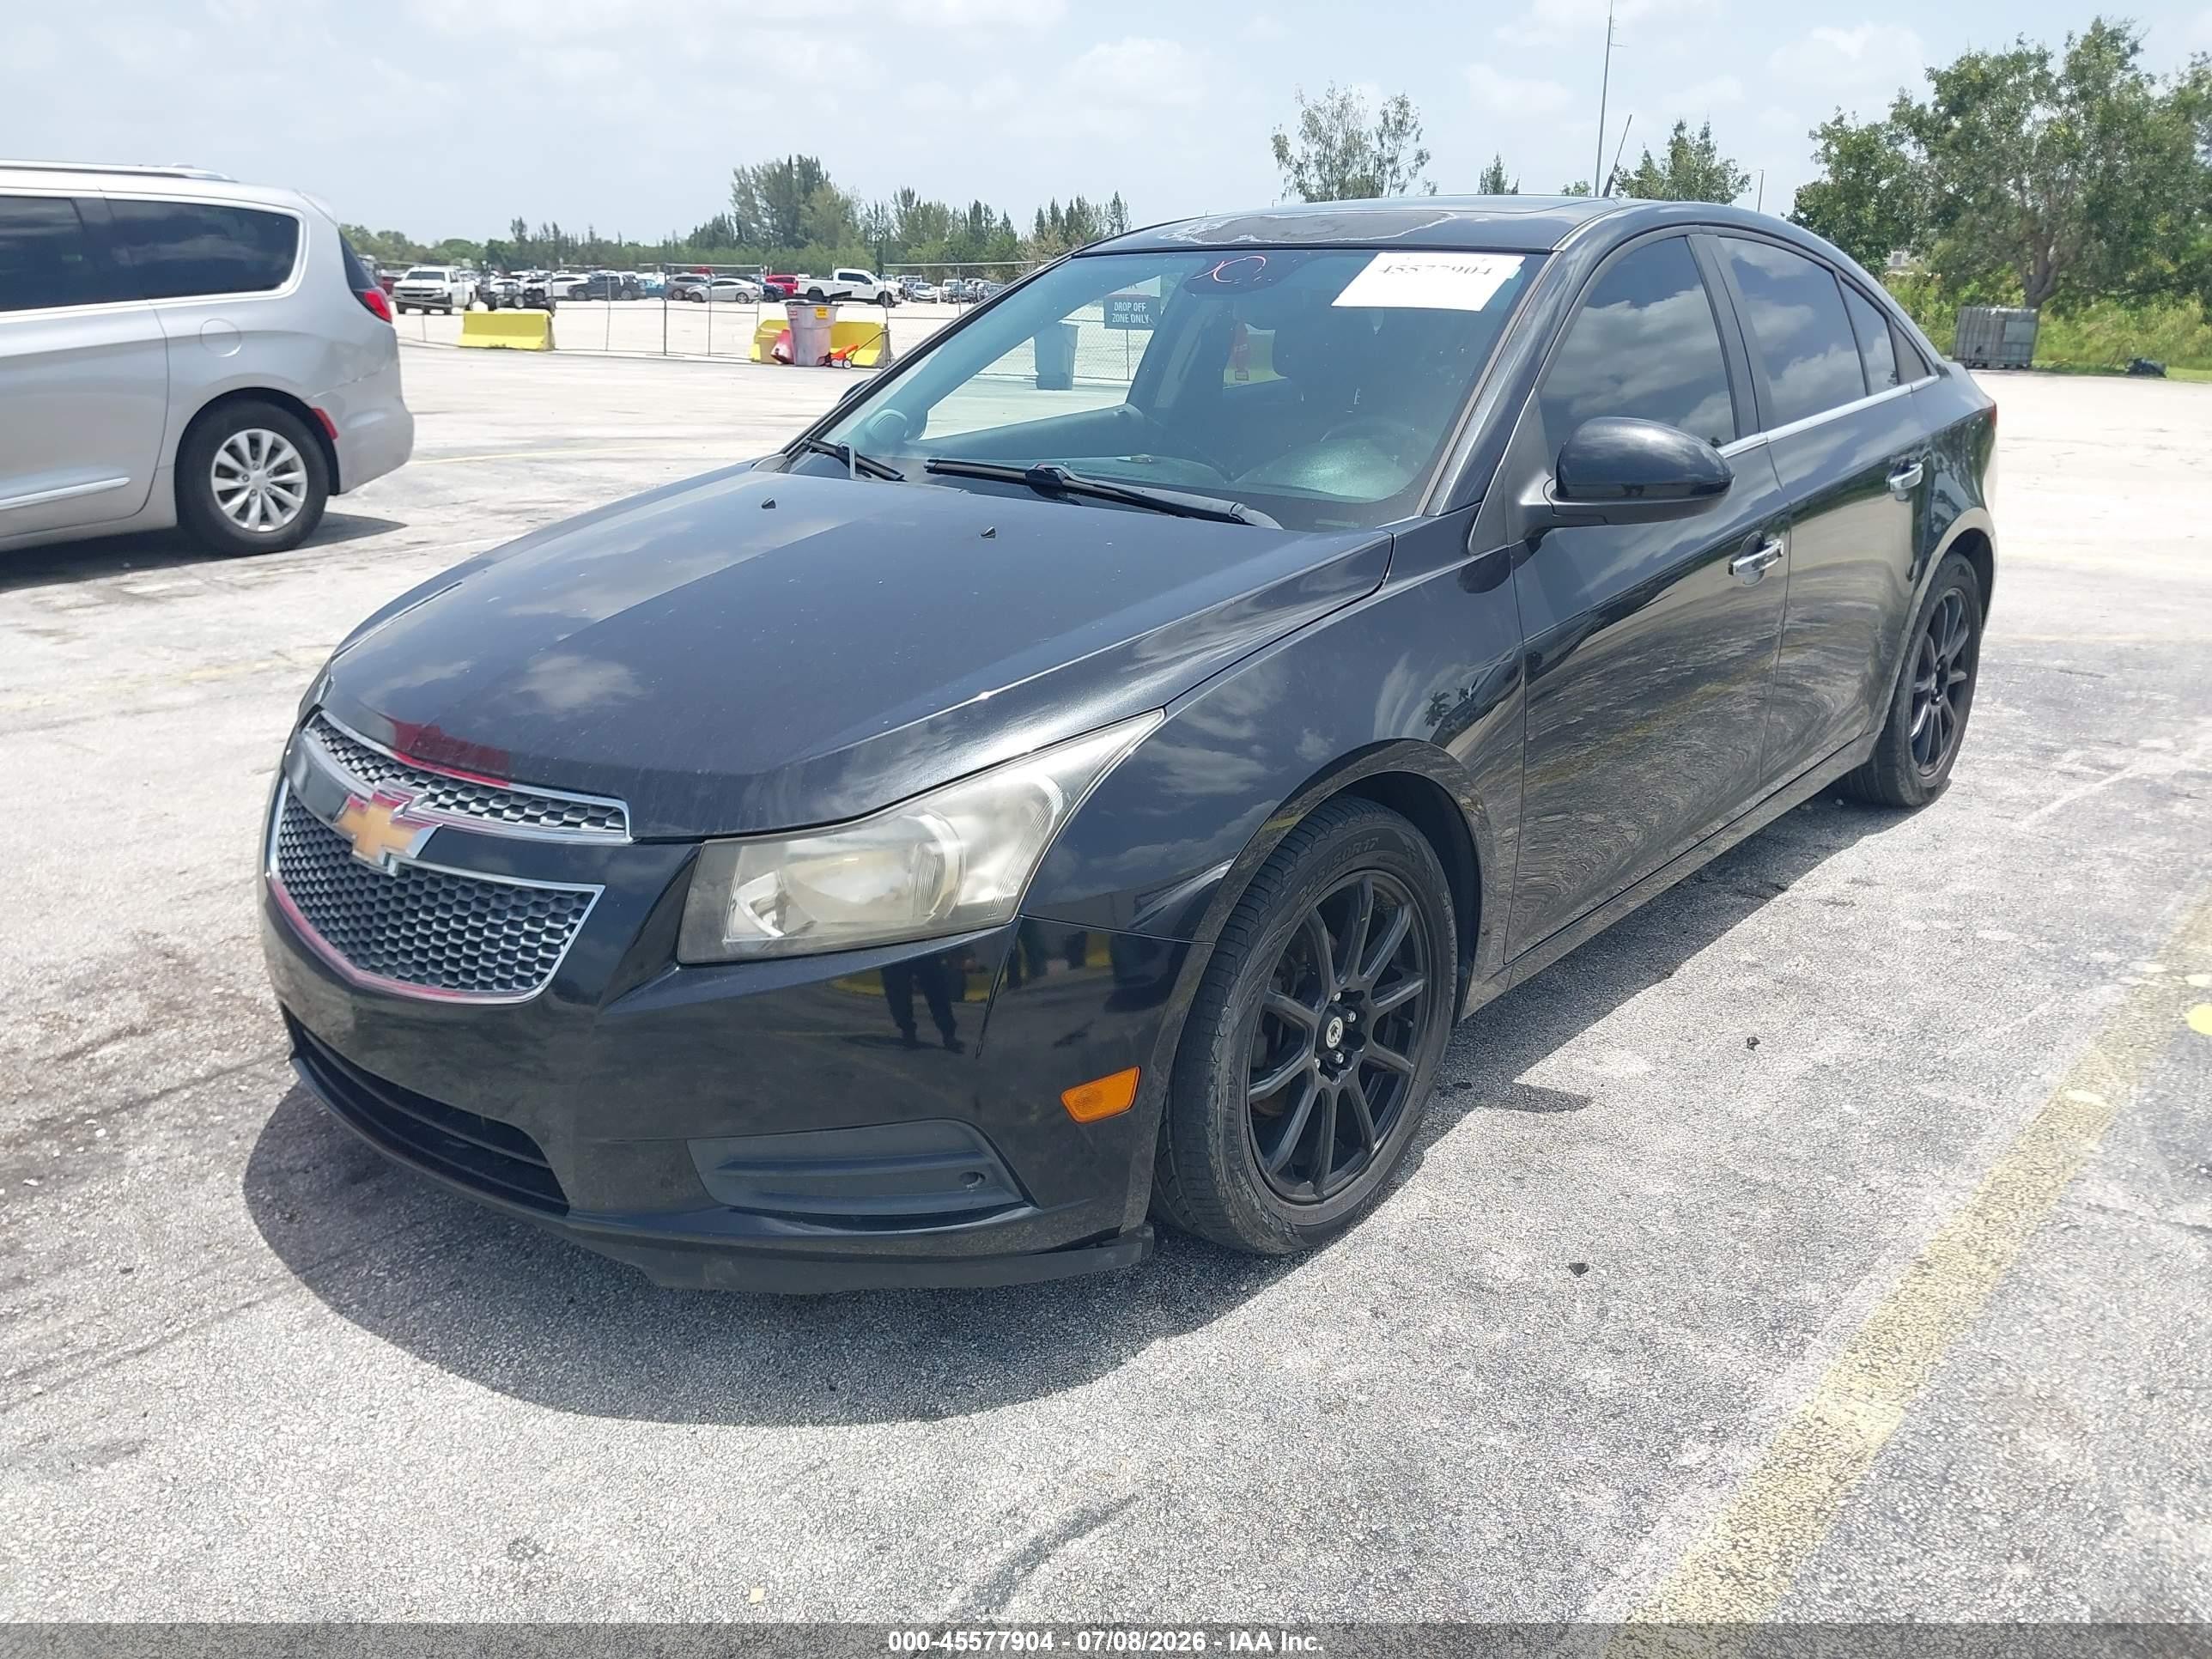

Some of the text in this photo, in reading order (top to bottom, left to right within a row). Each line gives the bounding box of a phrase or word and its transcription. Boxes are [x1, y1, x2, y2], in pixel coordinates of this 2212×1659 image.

[1114, 301, 1147, 312] DROP OFF
[1111, 313, 1150, 324] ZONE ONLY
